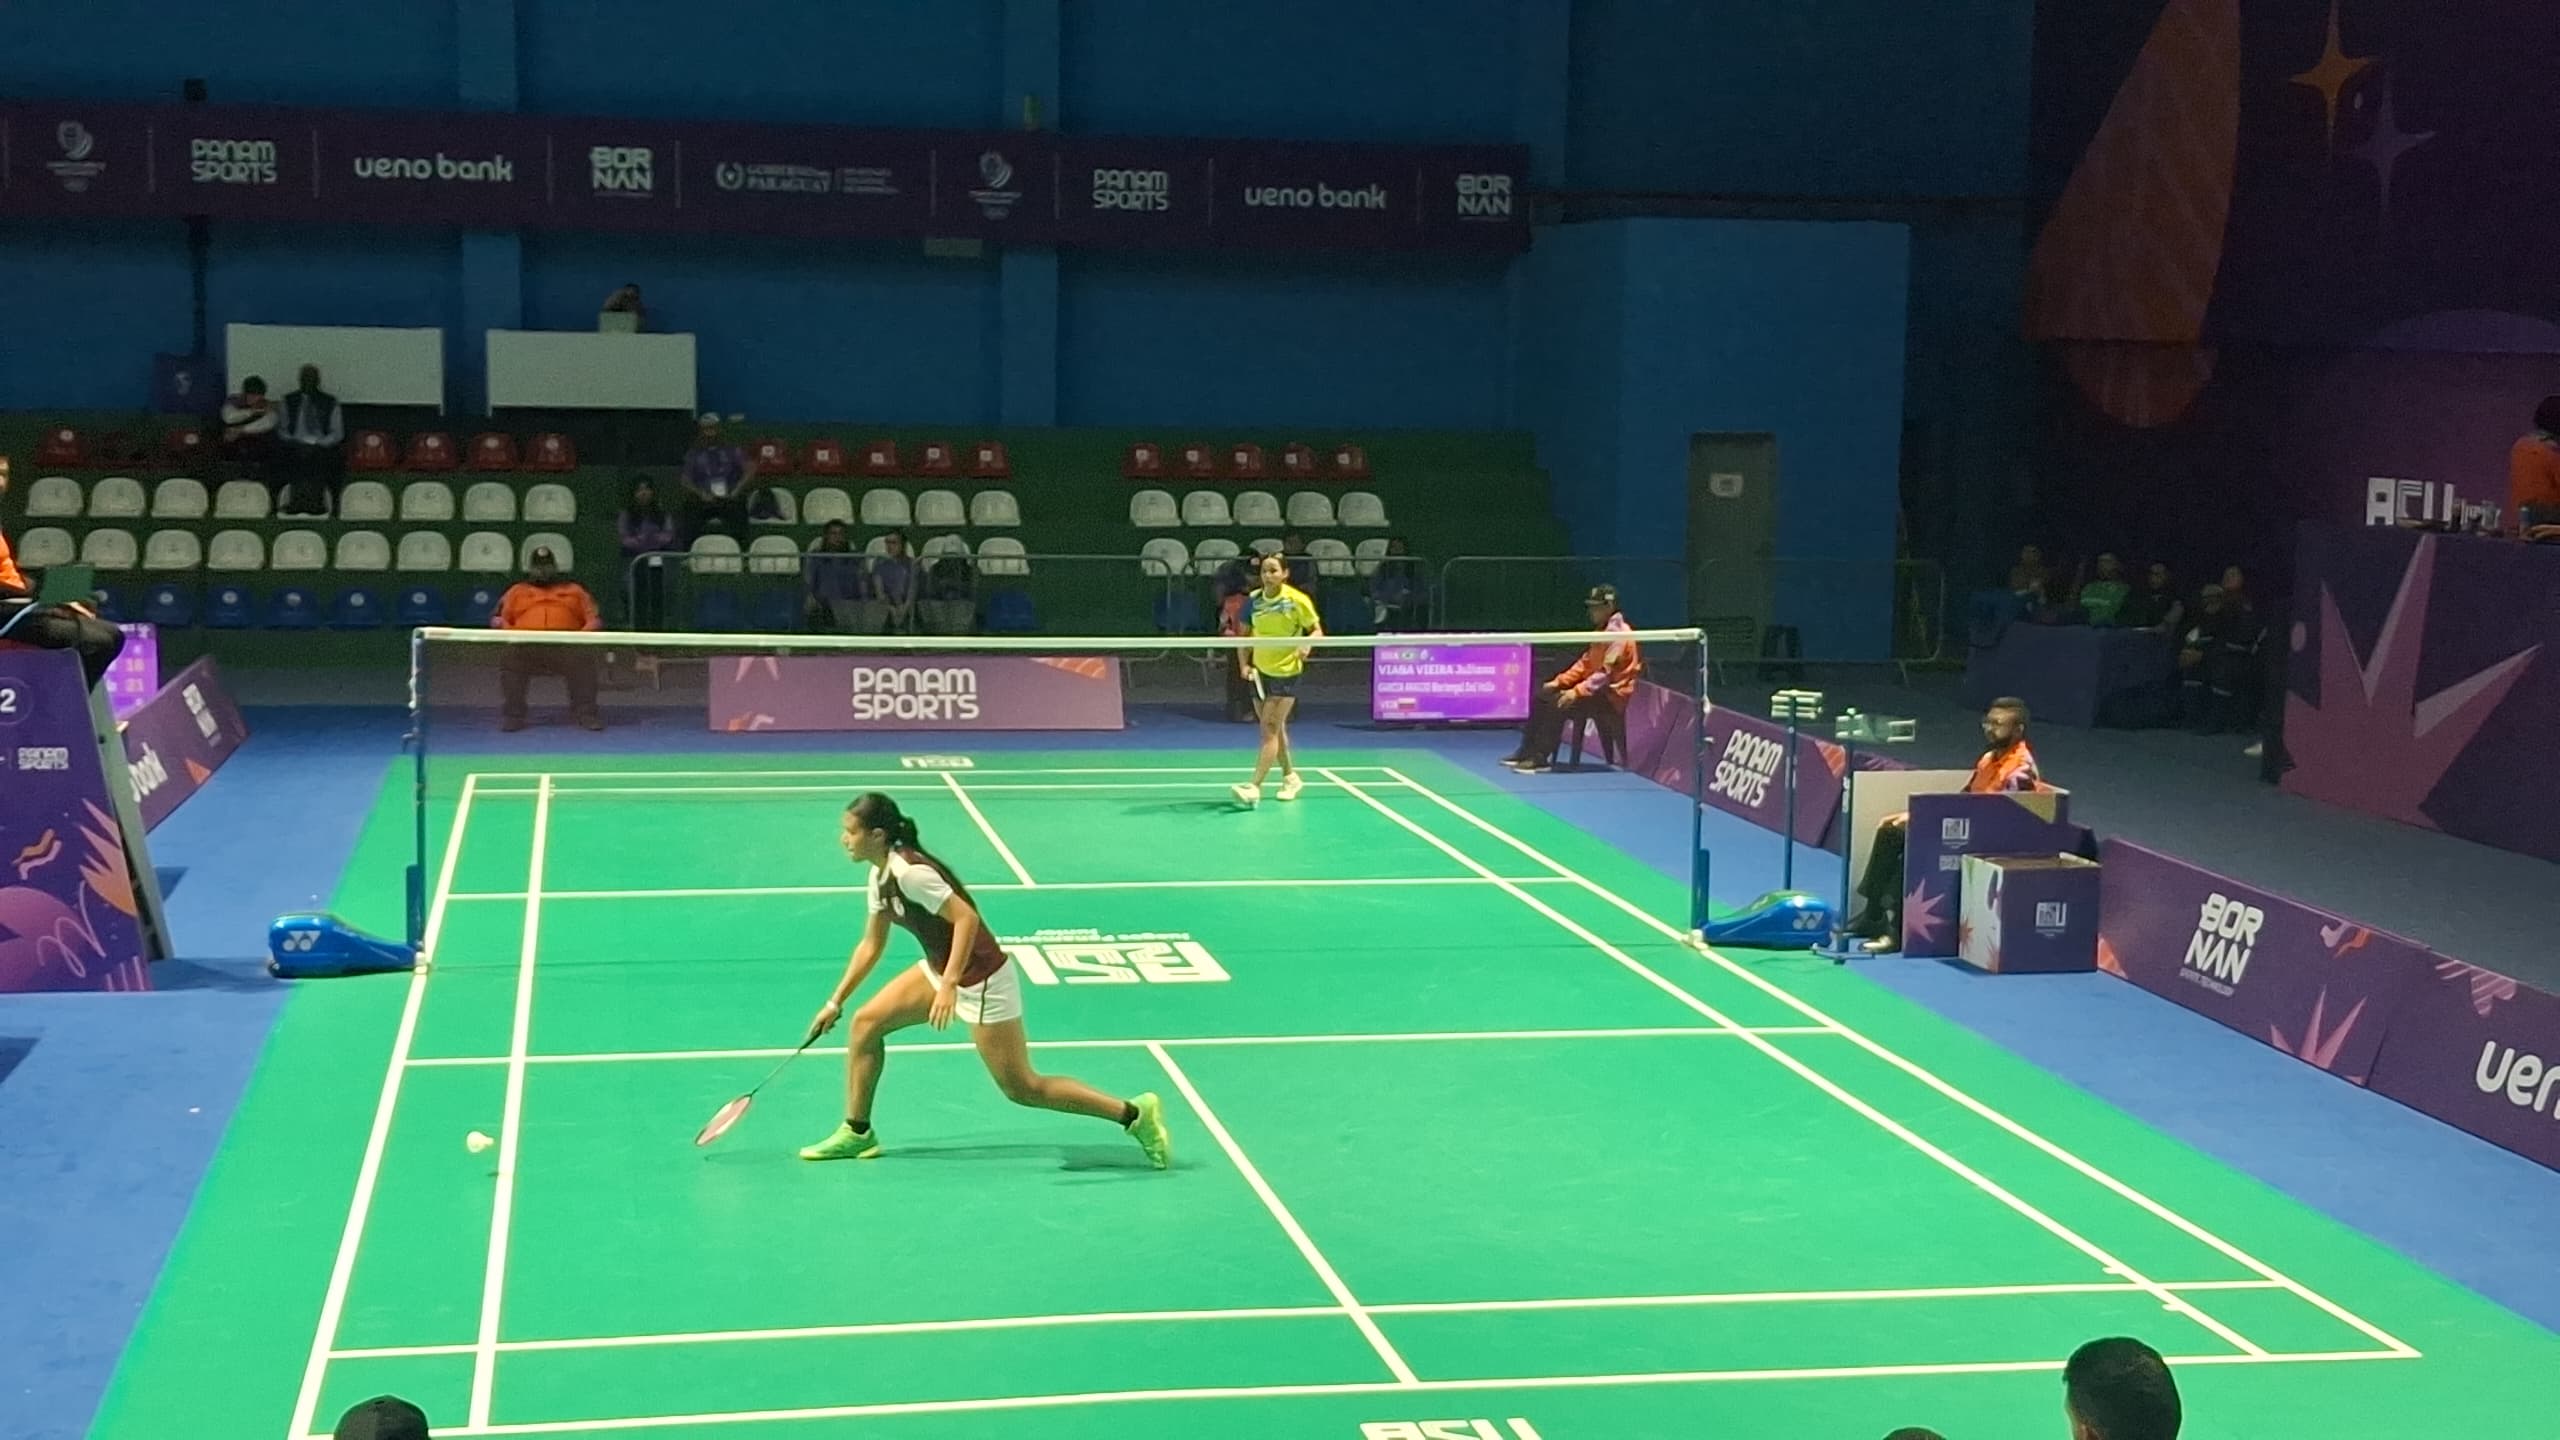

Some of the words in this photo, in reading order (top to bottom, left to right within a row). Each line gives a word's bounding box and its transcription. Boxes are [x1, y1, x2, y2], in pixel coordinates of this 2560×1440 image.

[190, 138, 276, 161] PANAM
[588, 146, 652, 169] BOR
[190, 161, 278, 184] SPORTS
[353, 155, 432, 181] ueno
[436, 152, 513, 183] bank
[1092, 168, 1168, 190] PANAM
[592, 169, 653, 191] NAN
[1456, 173, 1511, 195] BOR
[1092, 190, 1168, 212] SPORTS
[1244, 185, 1313, 209] ueno
[1318, 182, 1386, 210] bank
[1456, 194, 1511, 216] NAN
[852, 667, 977, 693] PANAM
[0, 688, 17, 712] 2
[851, 693, 980, 721] SPORTS
[1722, 728, 1784, 775] PANAM
[1708, 760, 1771, 808] SPORTS
[2198, 892, 2265, 948] BOR
[2183, 928, 2252, 985] NAN
